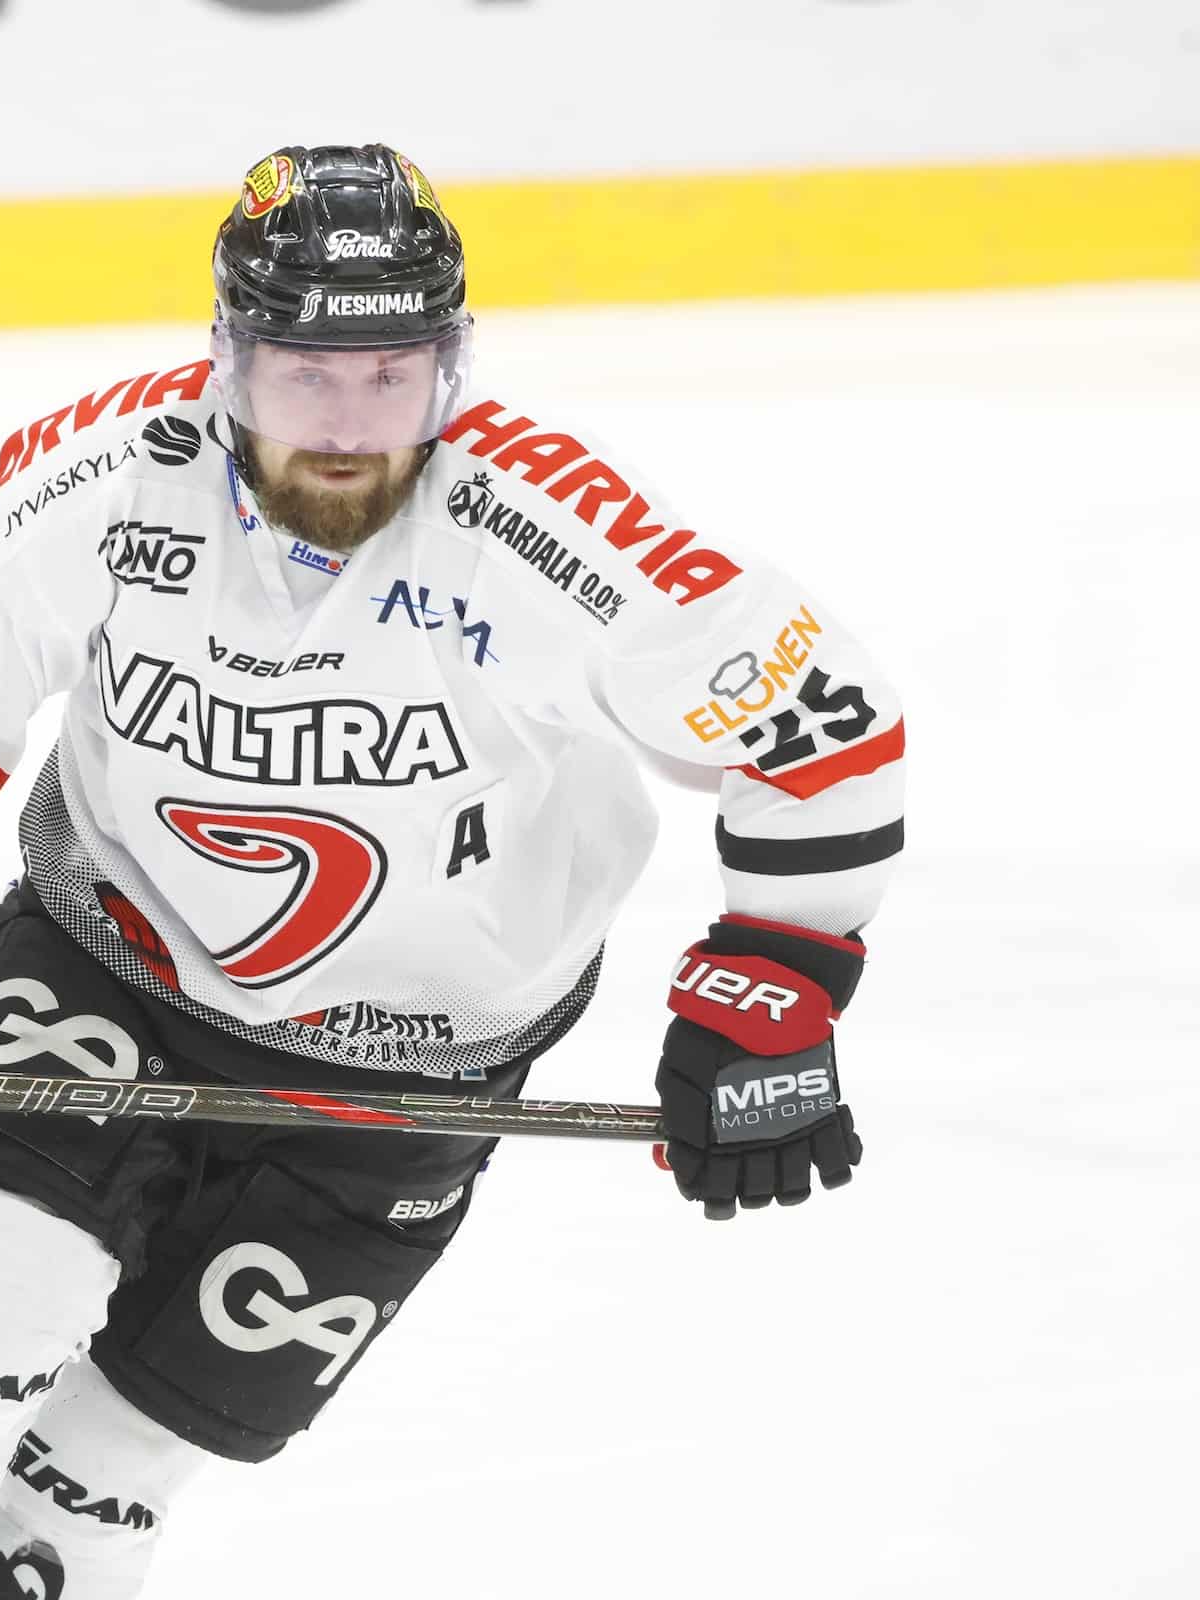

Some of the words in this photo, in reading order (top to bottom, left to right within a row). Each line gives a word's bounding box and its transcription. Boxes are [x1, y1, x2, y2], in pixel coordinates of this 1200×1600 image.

[326, 229, 394, 261] Panda
[327, 292, 425, 316] KESKIMAA
[4, 438, 137, 538] JYVÄSKYLÄ
[440, 399, 744, 607] HARVIA
[484, 501, 582, 592] KARJALA
[99, 623, 469, 787] VALTRA
[683, 604, 824, 743] ELONEN
[738, 665, 877, 772] 25
[446, 802, 491, 879] A
[670, 955, 800, 1022] UER
[716, 1068, 831, 1113] MPS
[720, 1097, 834, 1129] MOTORS
[199, 1241, 377, 1387] GA
